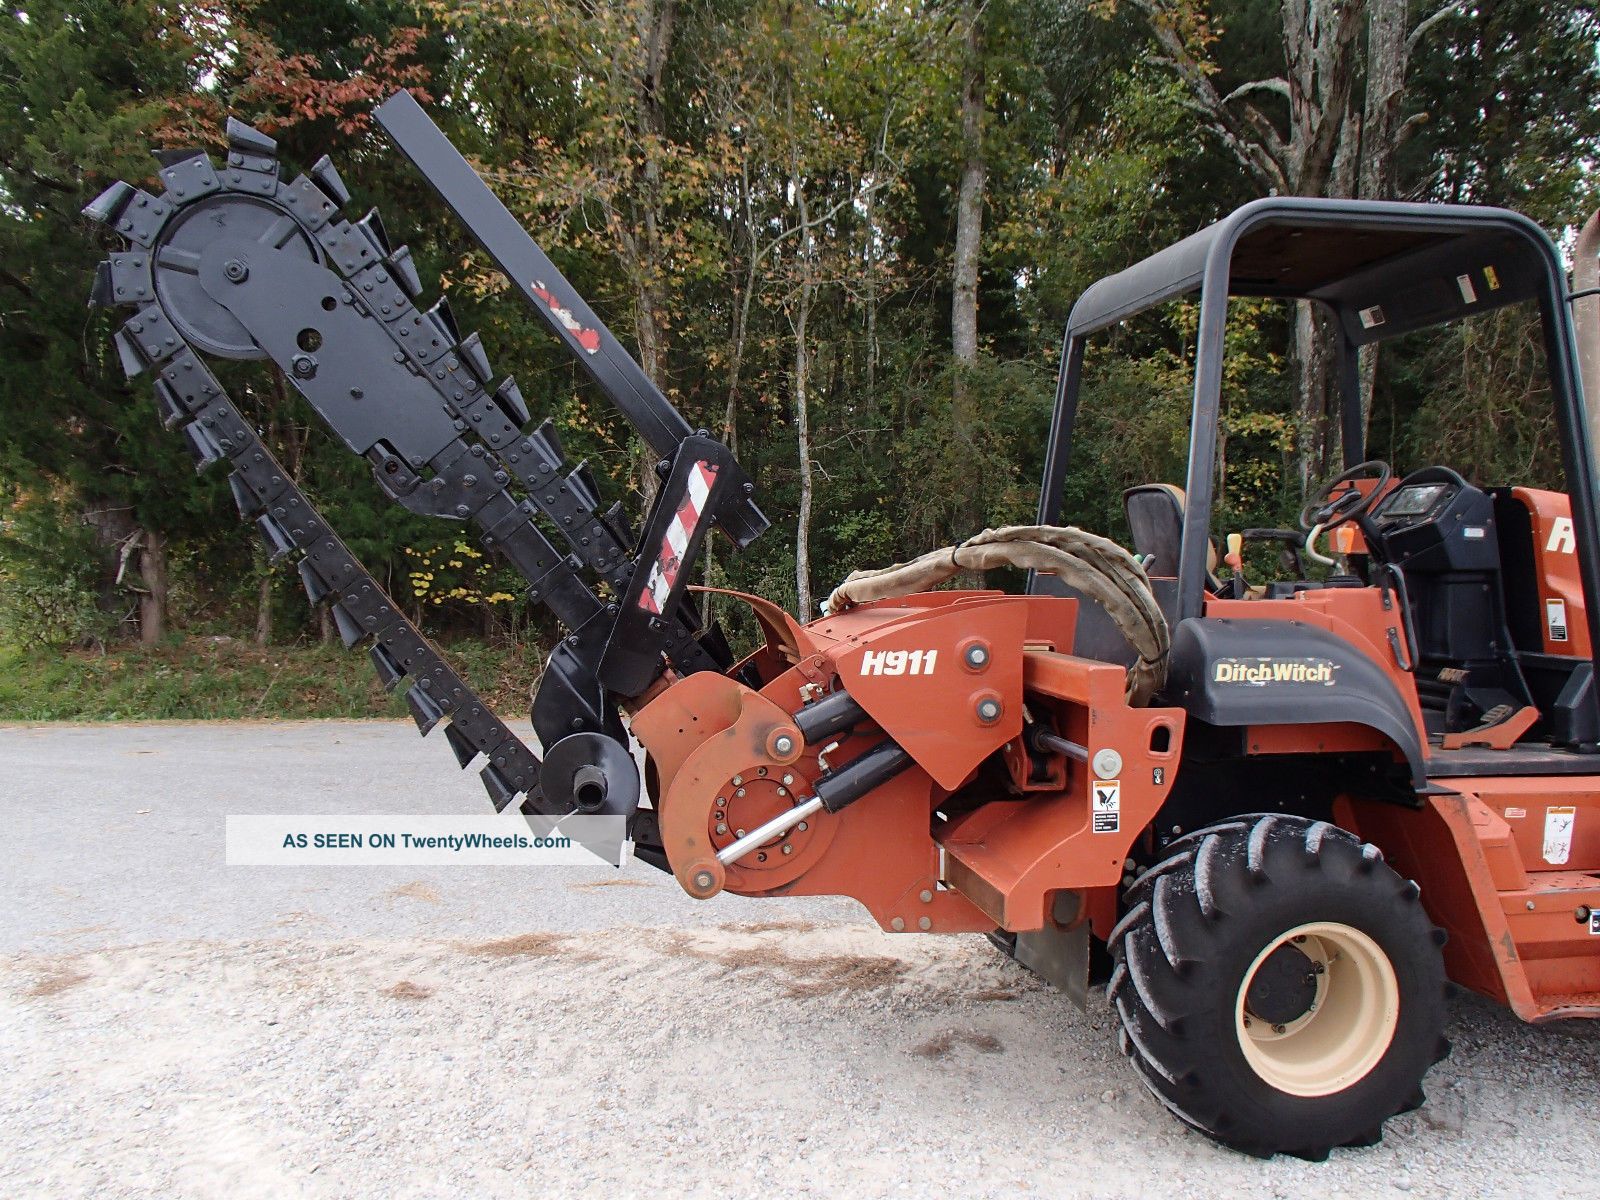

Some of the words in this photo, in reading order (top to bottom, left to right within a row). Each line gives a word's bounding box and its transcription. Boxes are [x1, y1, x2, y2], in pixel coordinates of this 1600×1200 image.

[860, 649, 938, 676] H911
[1215, 663, 1272, 682] Ditch
[1273, 663, 1331, 682] Witch
